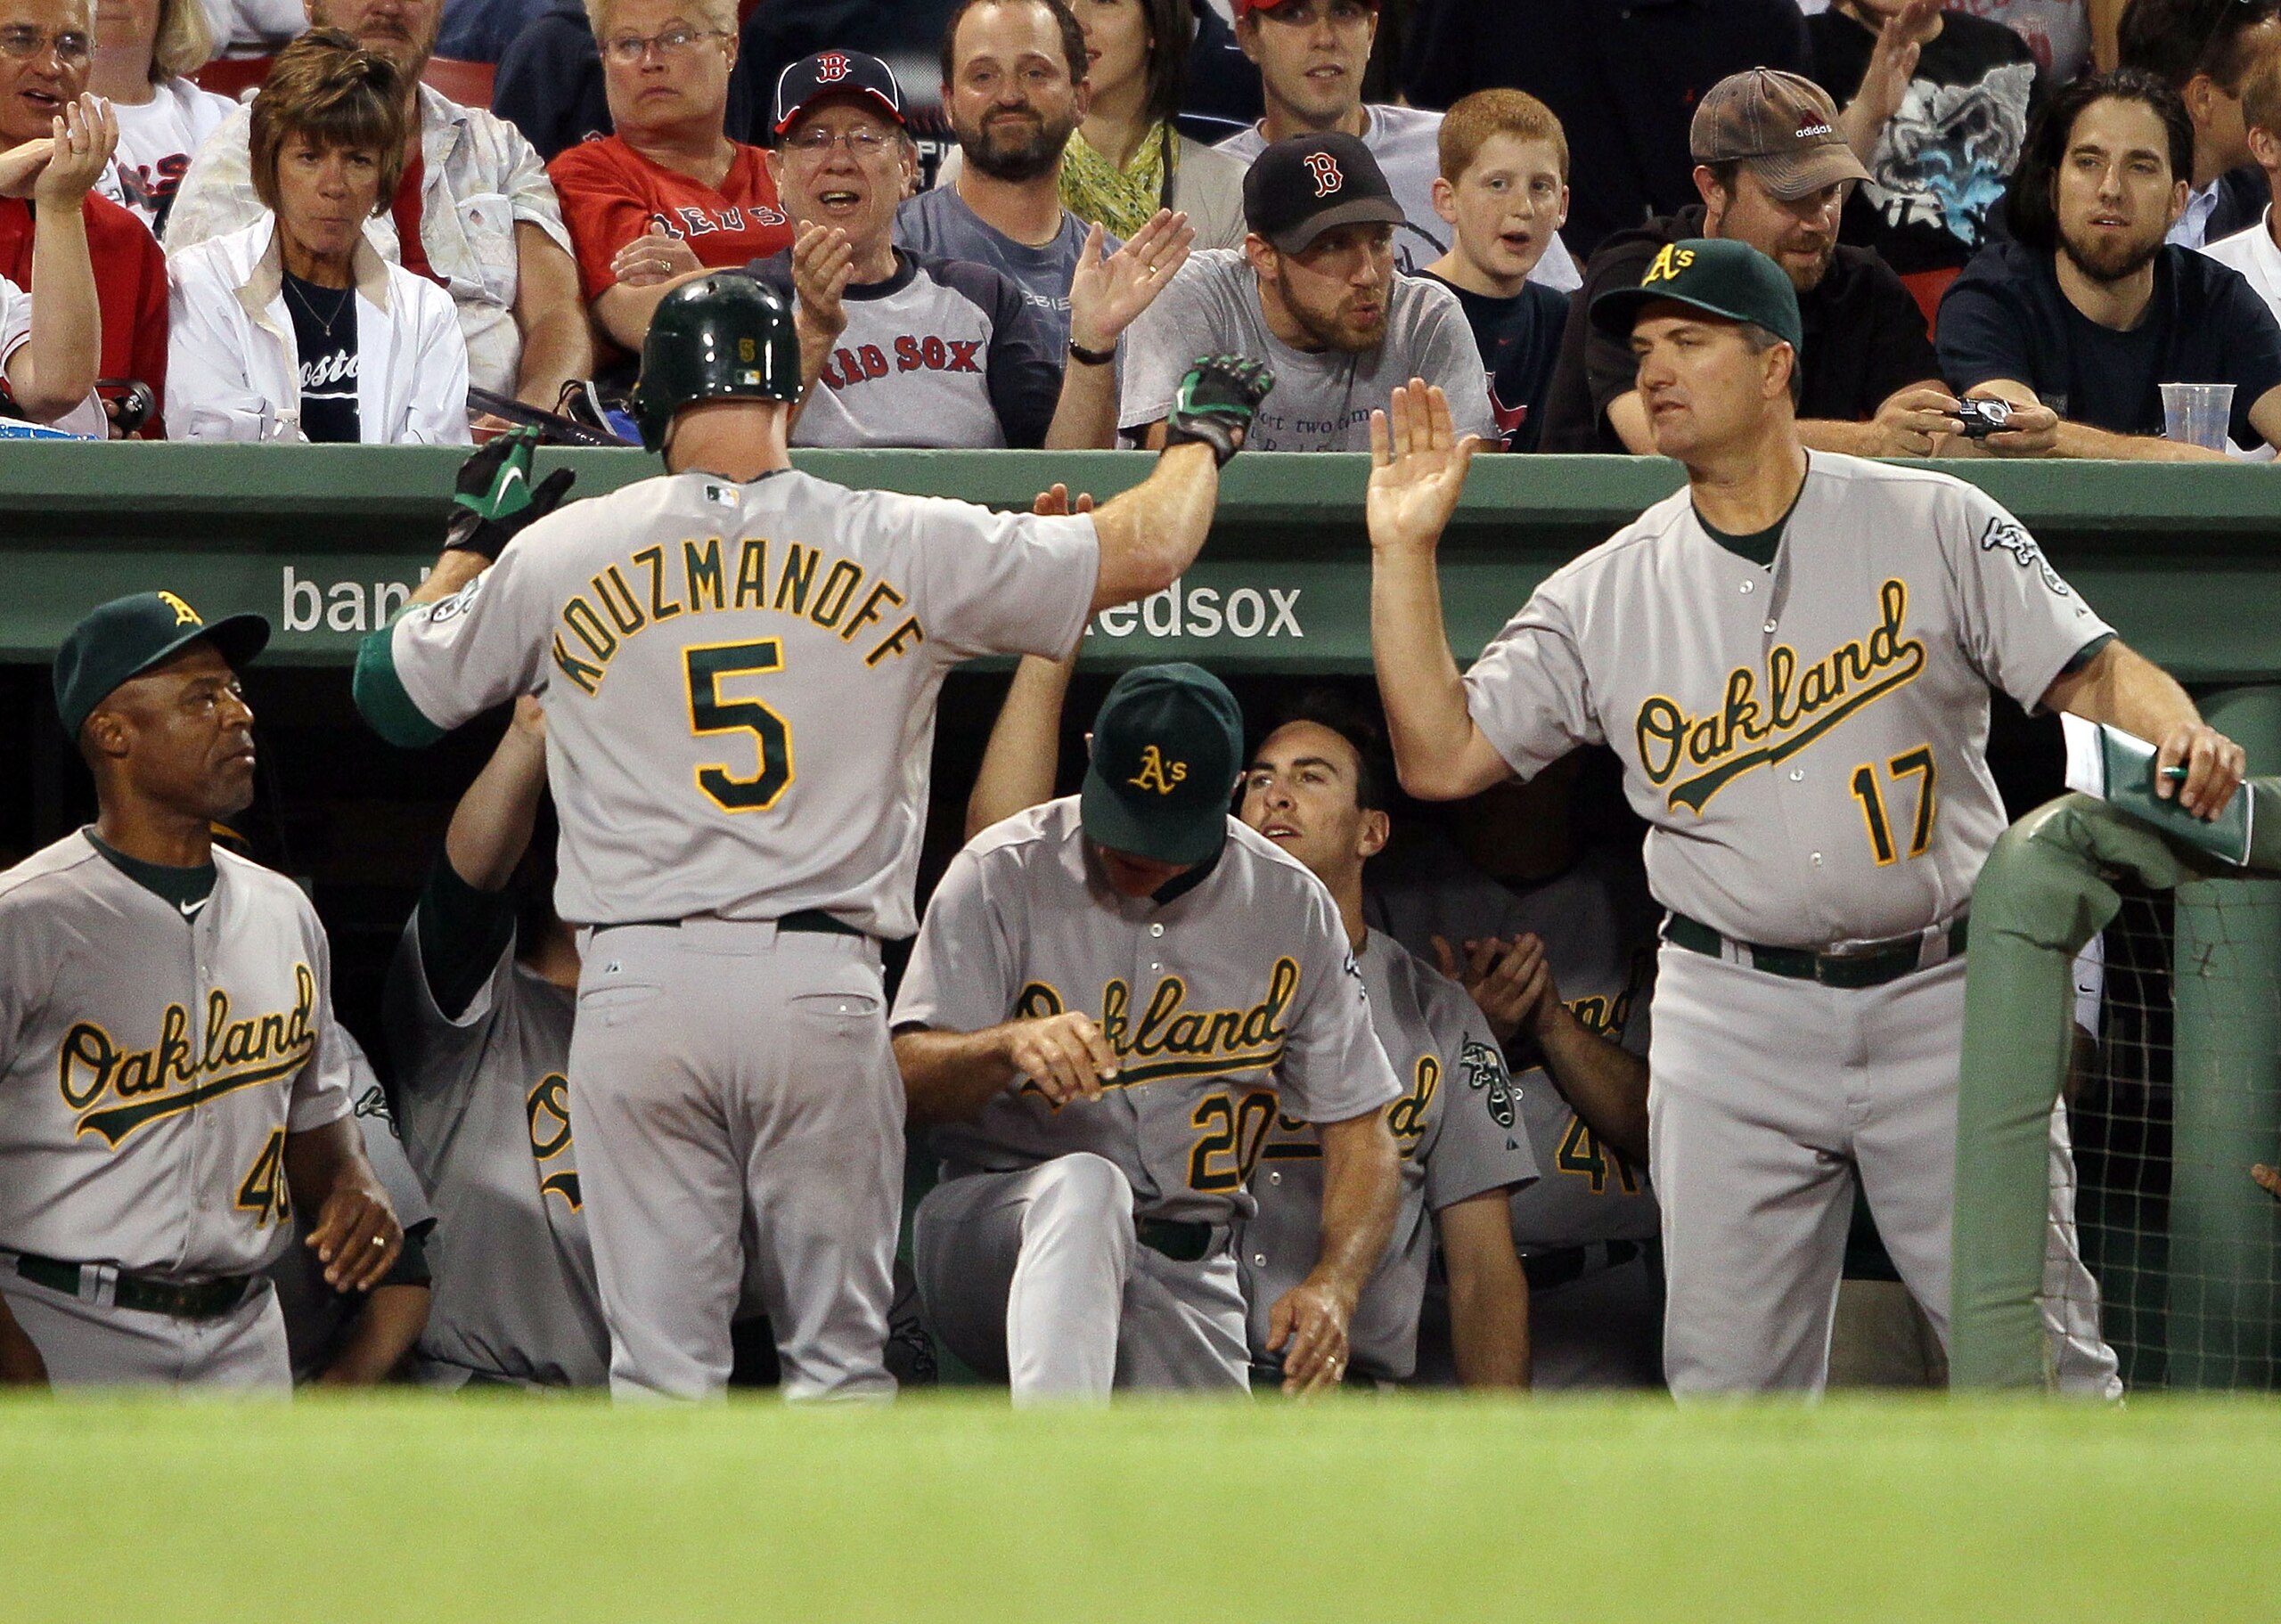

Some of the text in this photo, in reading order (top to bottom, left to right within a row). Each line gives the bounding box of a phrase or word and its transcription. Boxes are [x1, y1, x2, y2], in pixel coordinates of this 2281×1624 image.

[815, 52, 853, 84] B
[1795, 124, 1832, 137] adidas
[1304, 151, 1344, 198] B
[1641, 243, 1696, 288] A's
[894, 335, 985, 374] SOX
[1296, 419, 1333, 434] two
[282, 565, 1304, 638] ban edsox
[552, 537, 925, 698] KOUZMANOFF
[1636, 577, 1927, 786] Oakland
[681, 636, 796, 814] 5
[1127, 744, 1188, 795] A's
[1850, 743, 1939, 867] 17
[59, 961, 319, 1113] Oakland
[233, 1125, 293, 1229] 4
[1186, 1092, 1279, 1194] 20
